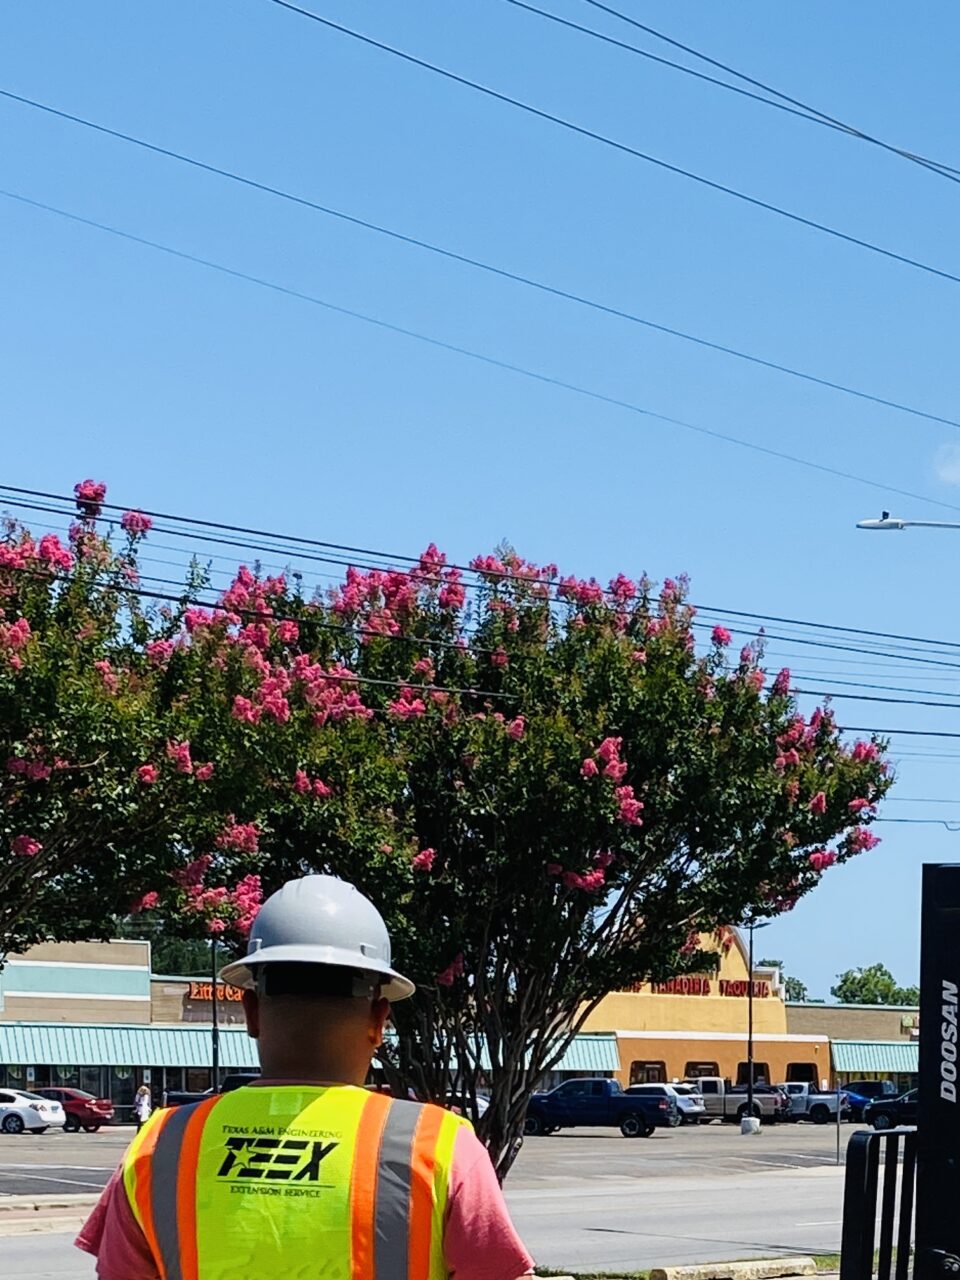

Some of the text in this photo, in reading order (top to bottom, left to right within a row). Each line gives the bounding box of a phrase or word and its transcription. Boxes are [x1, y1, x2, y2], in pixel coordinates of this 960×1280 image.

[190, 981, 225, 1001] Litte
[719, 979, 770, 997] TAQURIA
[940, 979, 959, 1103] DOOSAN
[222, 1125, 343, 1139] TEXAS A&M ENGINEERING
[217, 1136, 340, 1181] TEEX
[230, 1185, 321, 1198] EXTENSION SERVICE
